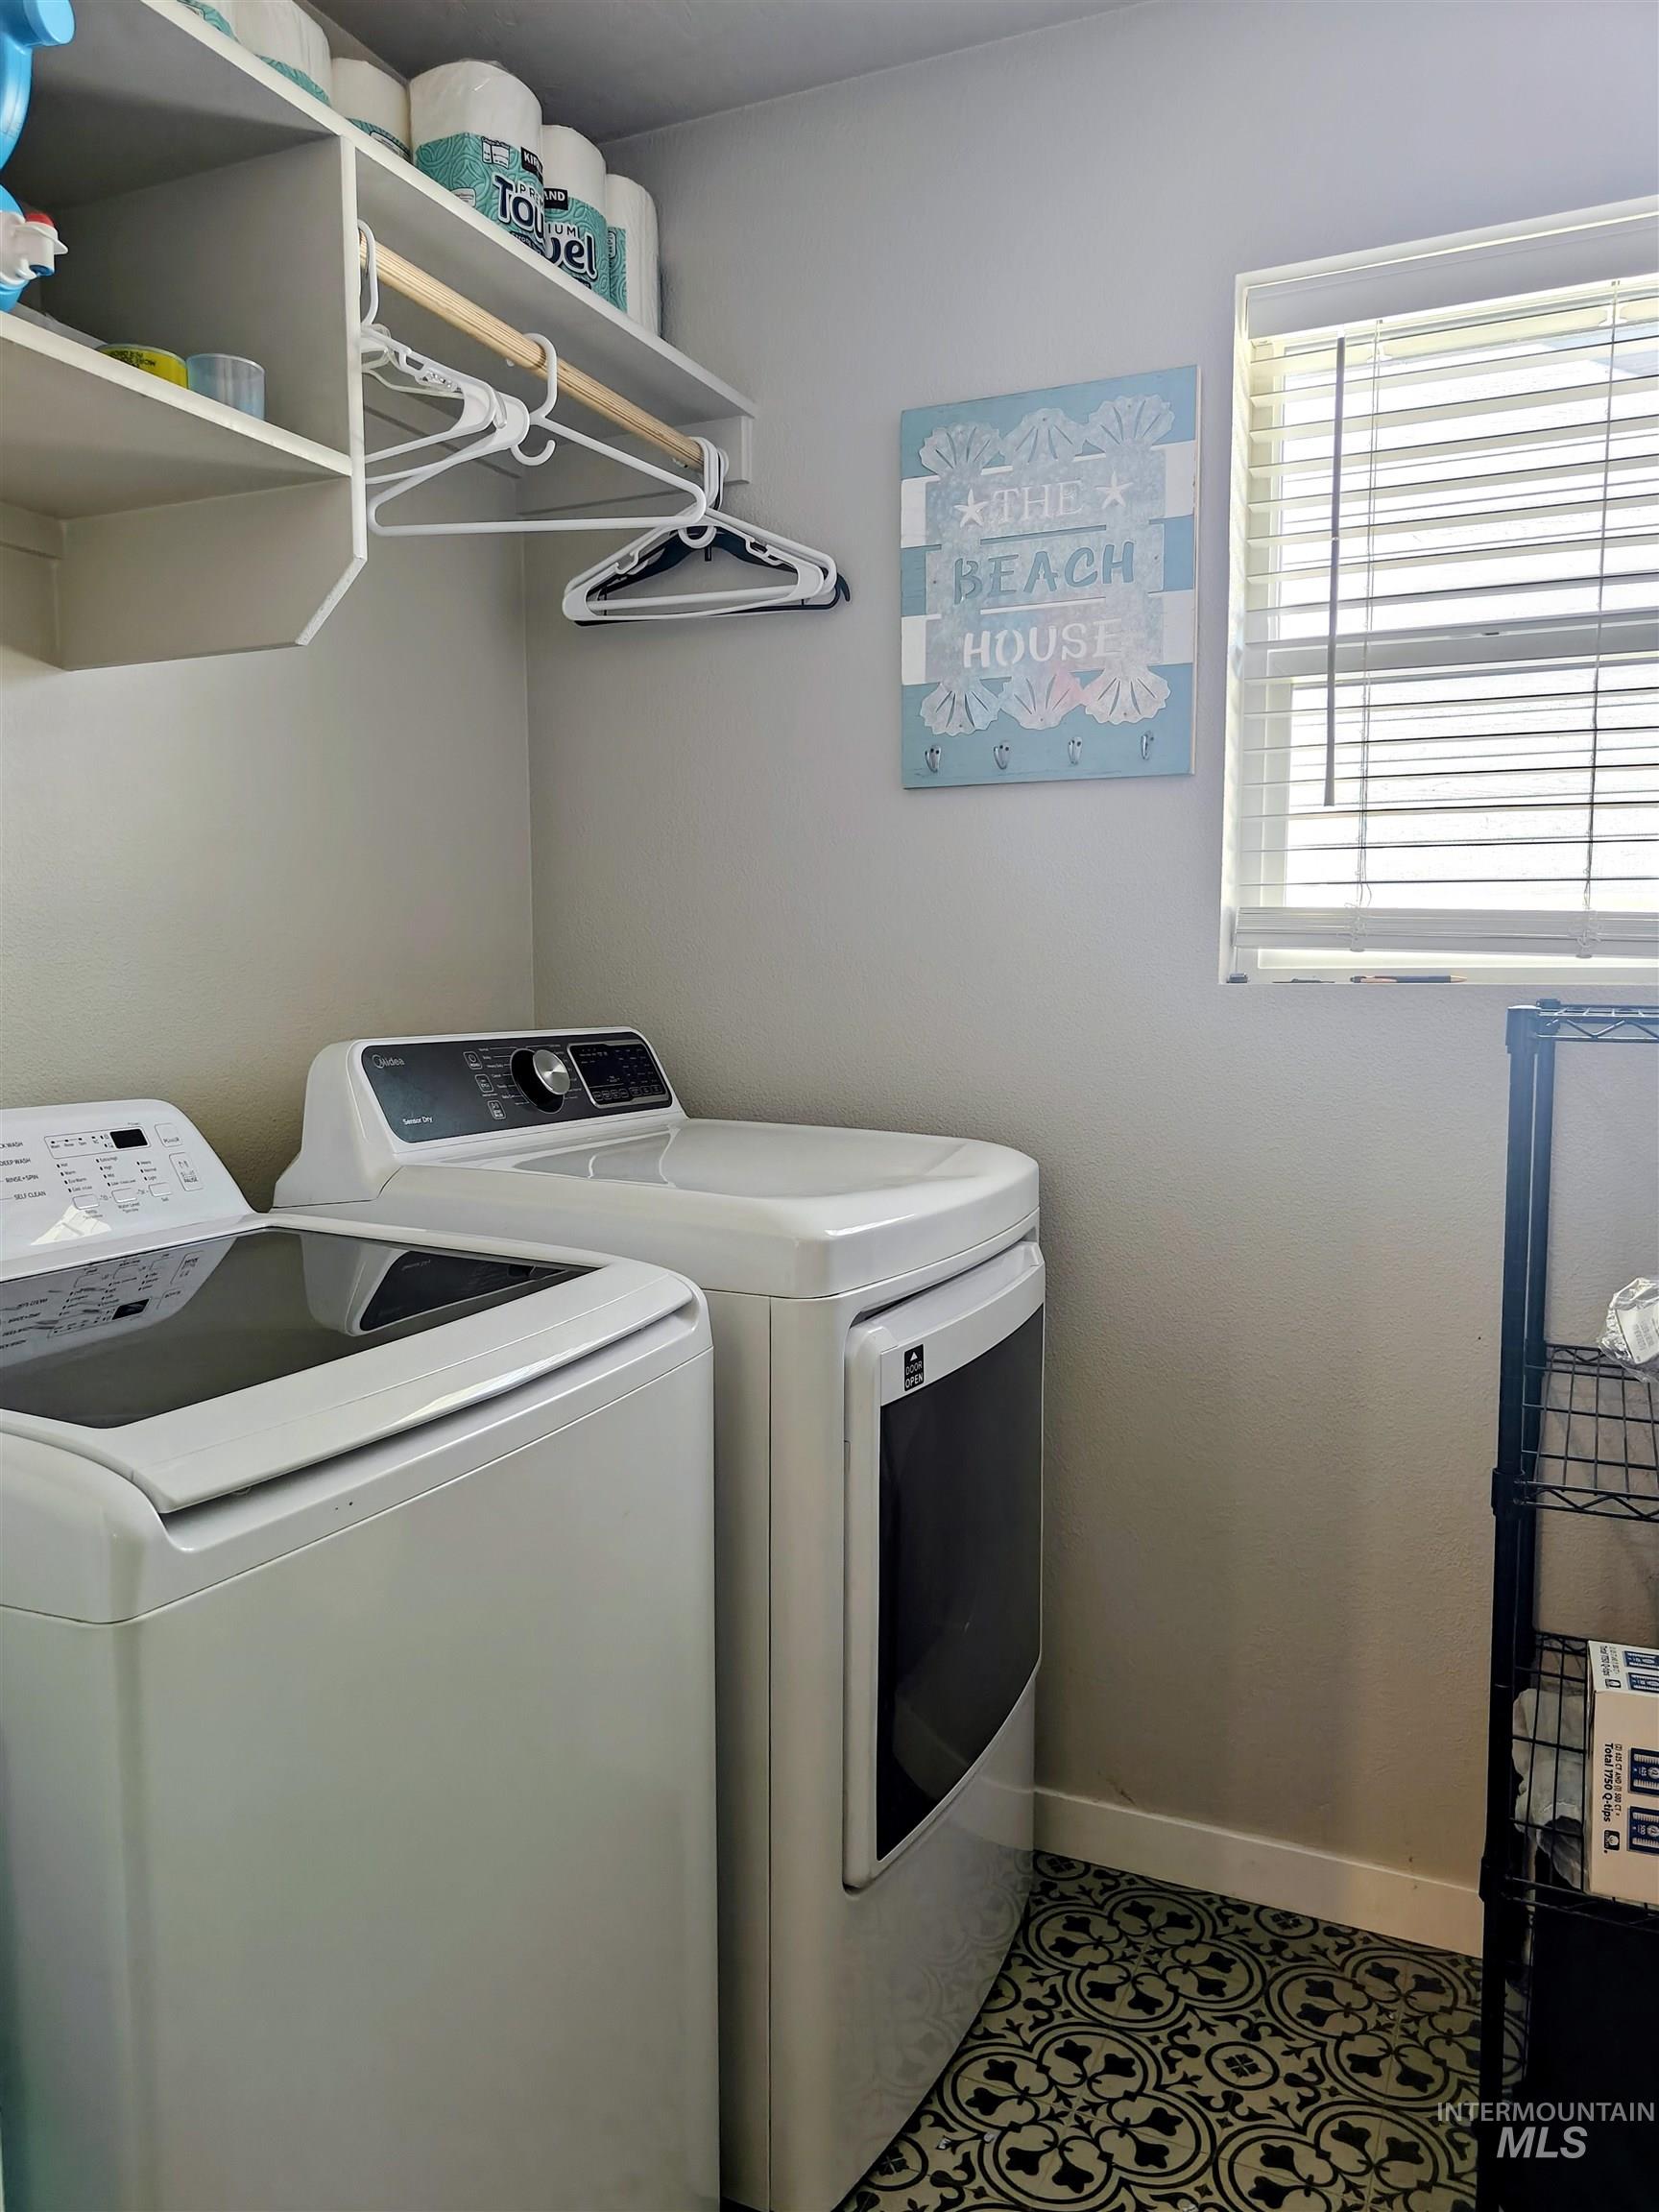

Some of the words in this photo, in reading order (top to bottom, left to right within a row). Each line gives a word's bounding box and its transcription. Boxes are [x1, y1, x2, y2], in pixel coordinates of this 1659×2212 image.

[990, 480, 1084, 525] THE
[954, 541, 1135, 605] BEACH
[963, 618, 1123, 669] HOUSE
[375, 1056, 405, 1068] Midea
[905, 1360, 923, 1376] DOOR
[905, 1372, 924, 1388] OPEN
[1604, 1743, 1614, 1767] Total
[1603, 1768, 1613, 1791] 1750
[1614, 1772, 1623, 1785] AND
[1601, 1792, 1613, 1822] Q-tips
